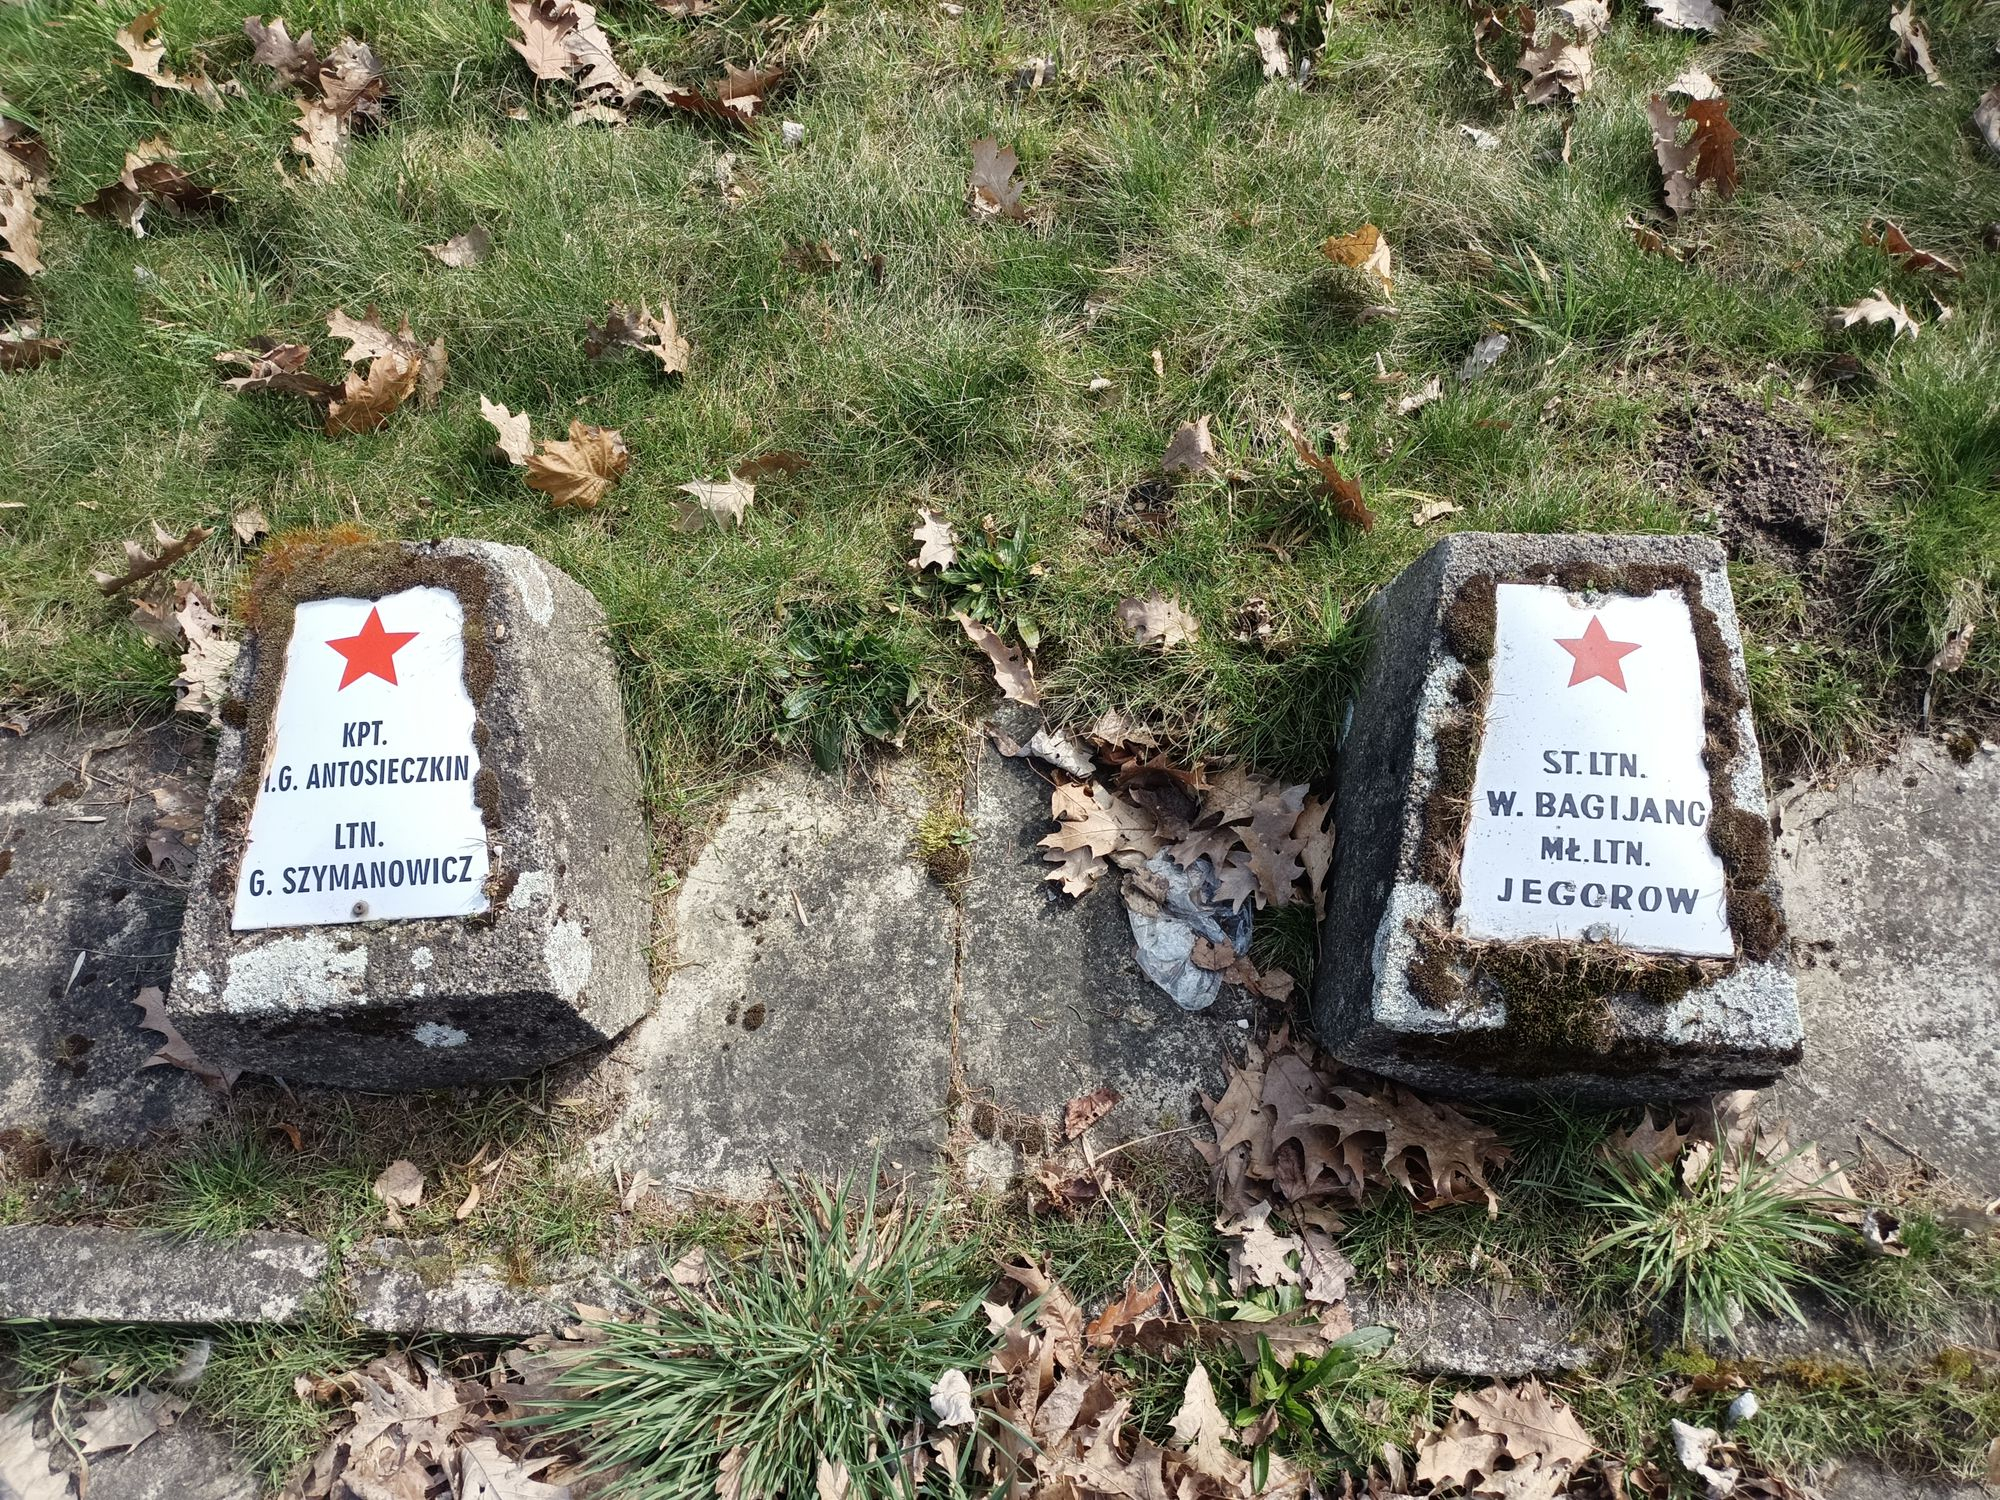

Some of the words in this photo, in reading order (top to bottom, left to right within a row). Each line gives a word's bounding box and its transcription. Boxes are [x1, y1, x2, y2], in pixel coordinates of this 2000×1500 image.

[342, 720, 388, 748] KPT.
[306, 755, 470, 790] ANTOSIECZKIN
[1543, 750, 1647, 779] ST.LTN.
[1486, 790, 1524, 817] W.
[1535, 791, 1706, 827] BAGIJANC
[335, 821, 385, 850] LTN.
[249, 869, 273, 897] G.
[282, 855, 473, 895] SZYMANOWICZ
